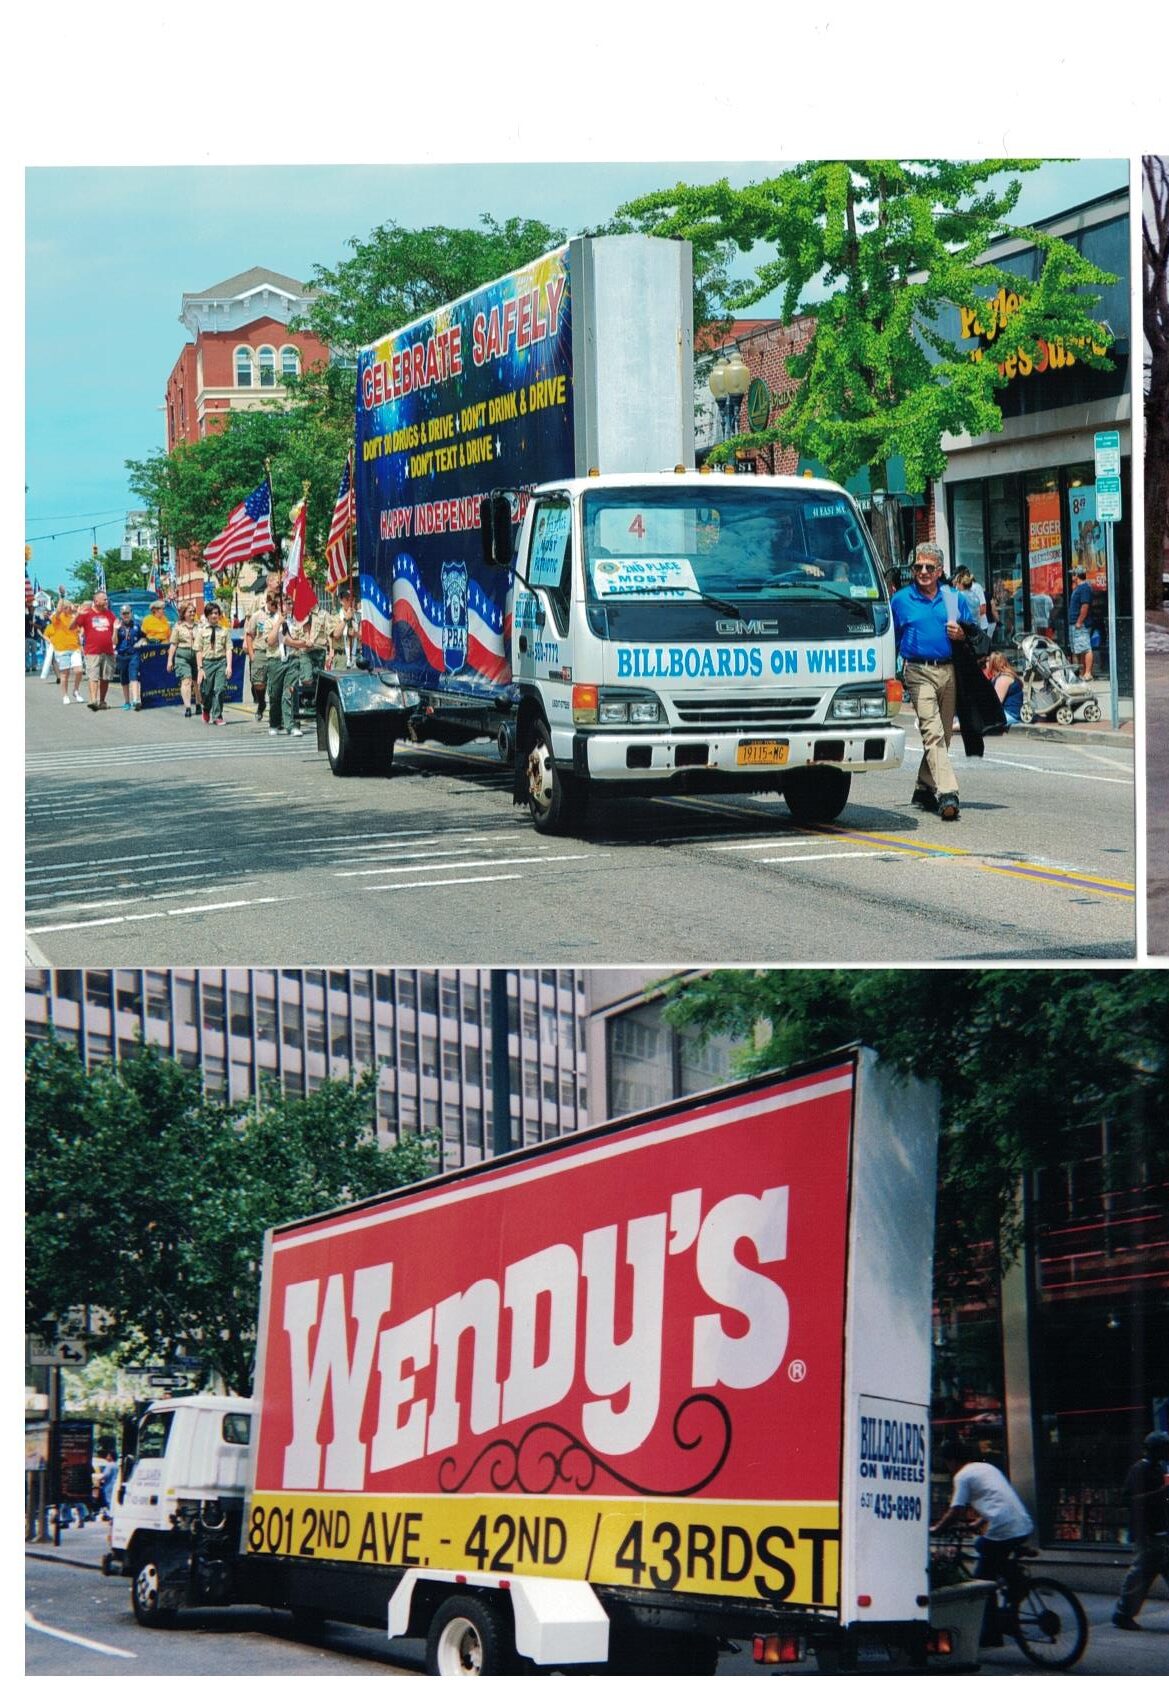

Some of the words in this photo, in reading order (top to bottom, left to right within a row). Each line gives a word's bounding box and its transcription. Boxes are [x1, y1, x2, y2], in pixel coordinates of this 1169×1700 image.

[363, 324, 462, 411] CELEBRATE
[473, 276, 566, 366] SAFELY
[363, 436, 383, 461] DON'T
[393, 424, 419, 452] DRUGS
[420, 422, 427, 445] &
[428, 413, 454, 442] DRIVE
[461, 402, 485, 432] DON'T
[489, 392, 518, 425] DRINK
[519, 391, 528, 415] &
[529, 375, 566, 412] DRIVE
[410, 453, 434, 479] DON'T
[435, 446, 457, 472] TEXT
[459, 445, 465, 467] &
[466, 435, 493, 466] DRIVE
[380, 505, 413, 540] HAPPY
[414, 494, 490, 537] INDEPENDE
[628, 514, 646, 539] 4
[1030, 520, 1061, 536] BIGGER
[540, 539, 557, 552] MOST
[618, 575, 667, 583] MOST
[625, 563, 645, 574] 2ND
[646, 561, 681, 571] PLACE
[447, 628, 464, 647] PBA
[715, 619, 779, 635] GMC
[617, 647, 763, 677] BILLBOARDS
[770, 649, 798, 674] ON
[806, 648, 876, 673] WHEELS
[860, 1416, 925, 1467] BILLBOARDS
[860, 1462, 877, 1478] ON
[882, 1465, 925, 1483] WHEELS
[874, 1493, 922, 1521] 435-8890
[250, 1506, 293, 1553] 801
[299, 1508, 350, 1555] 2ND
[358, 1511, 429, 1566] AVE.
[465, 1515, 567, 1572] 42ND
